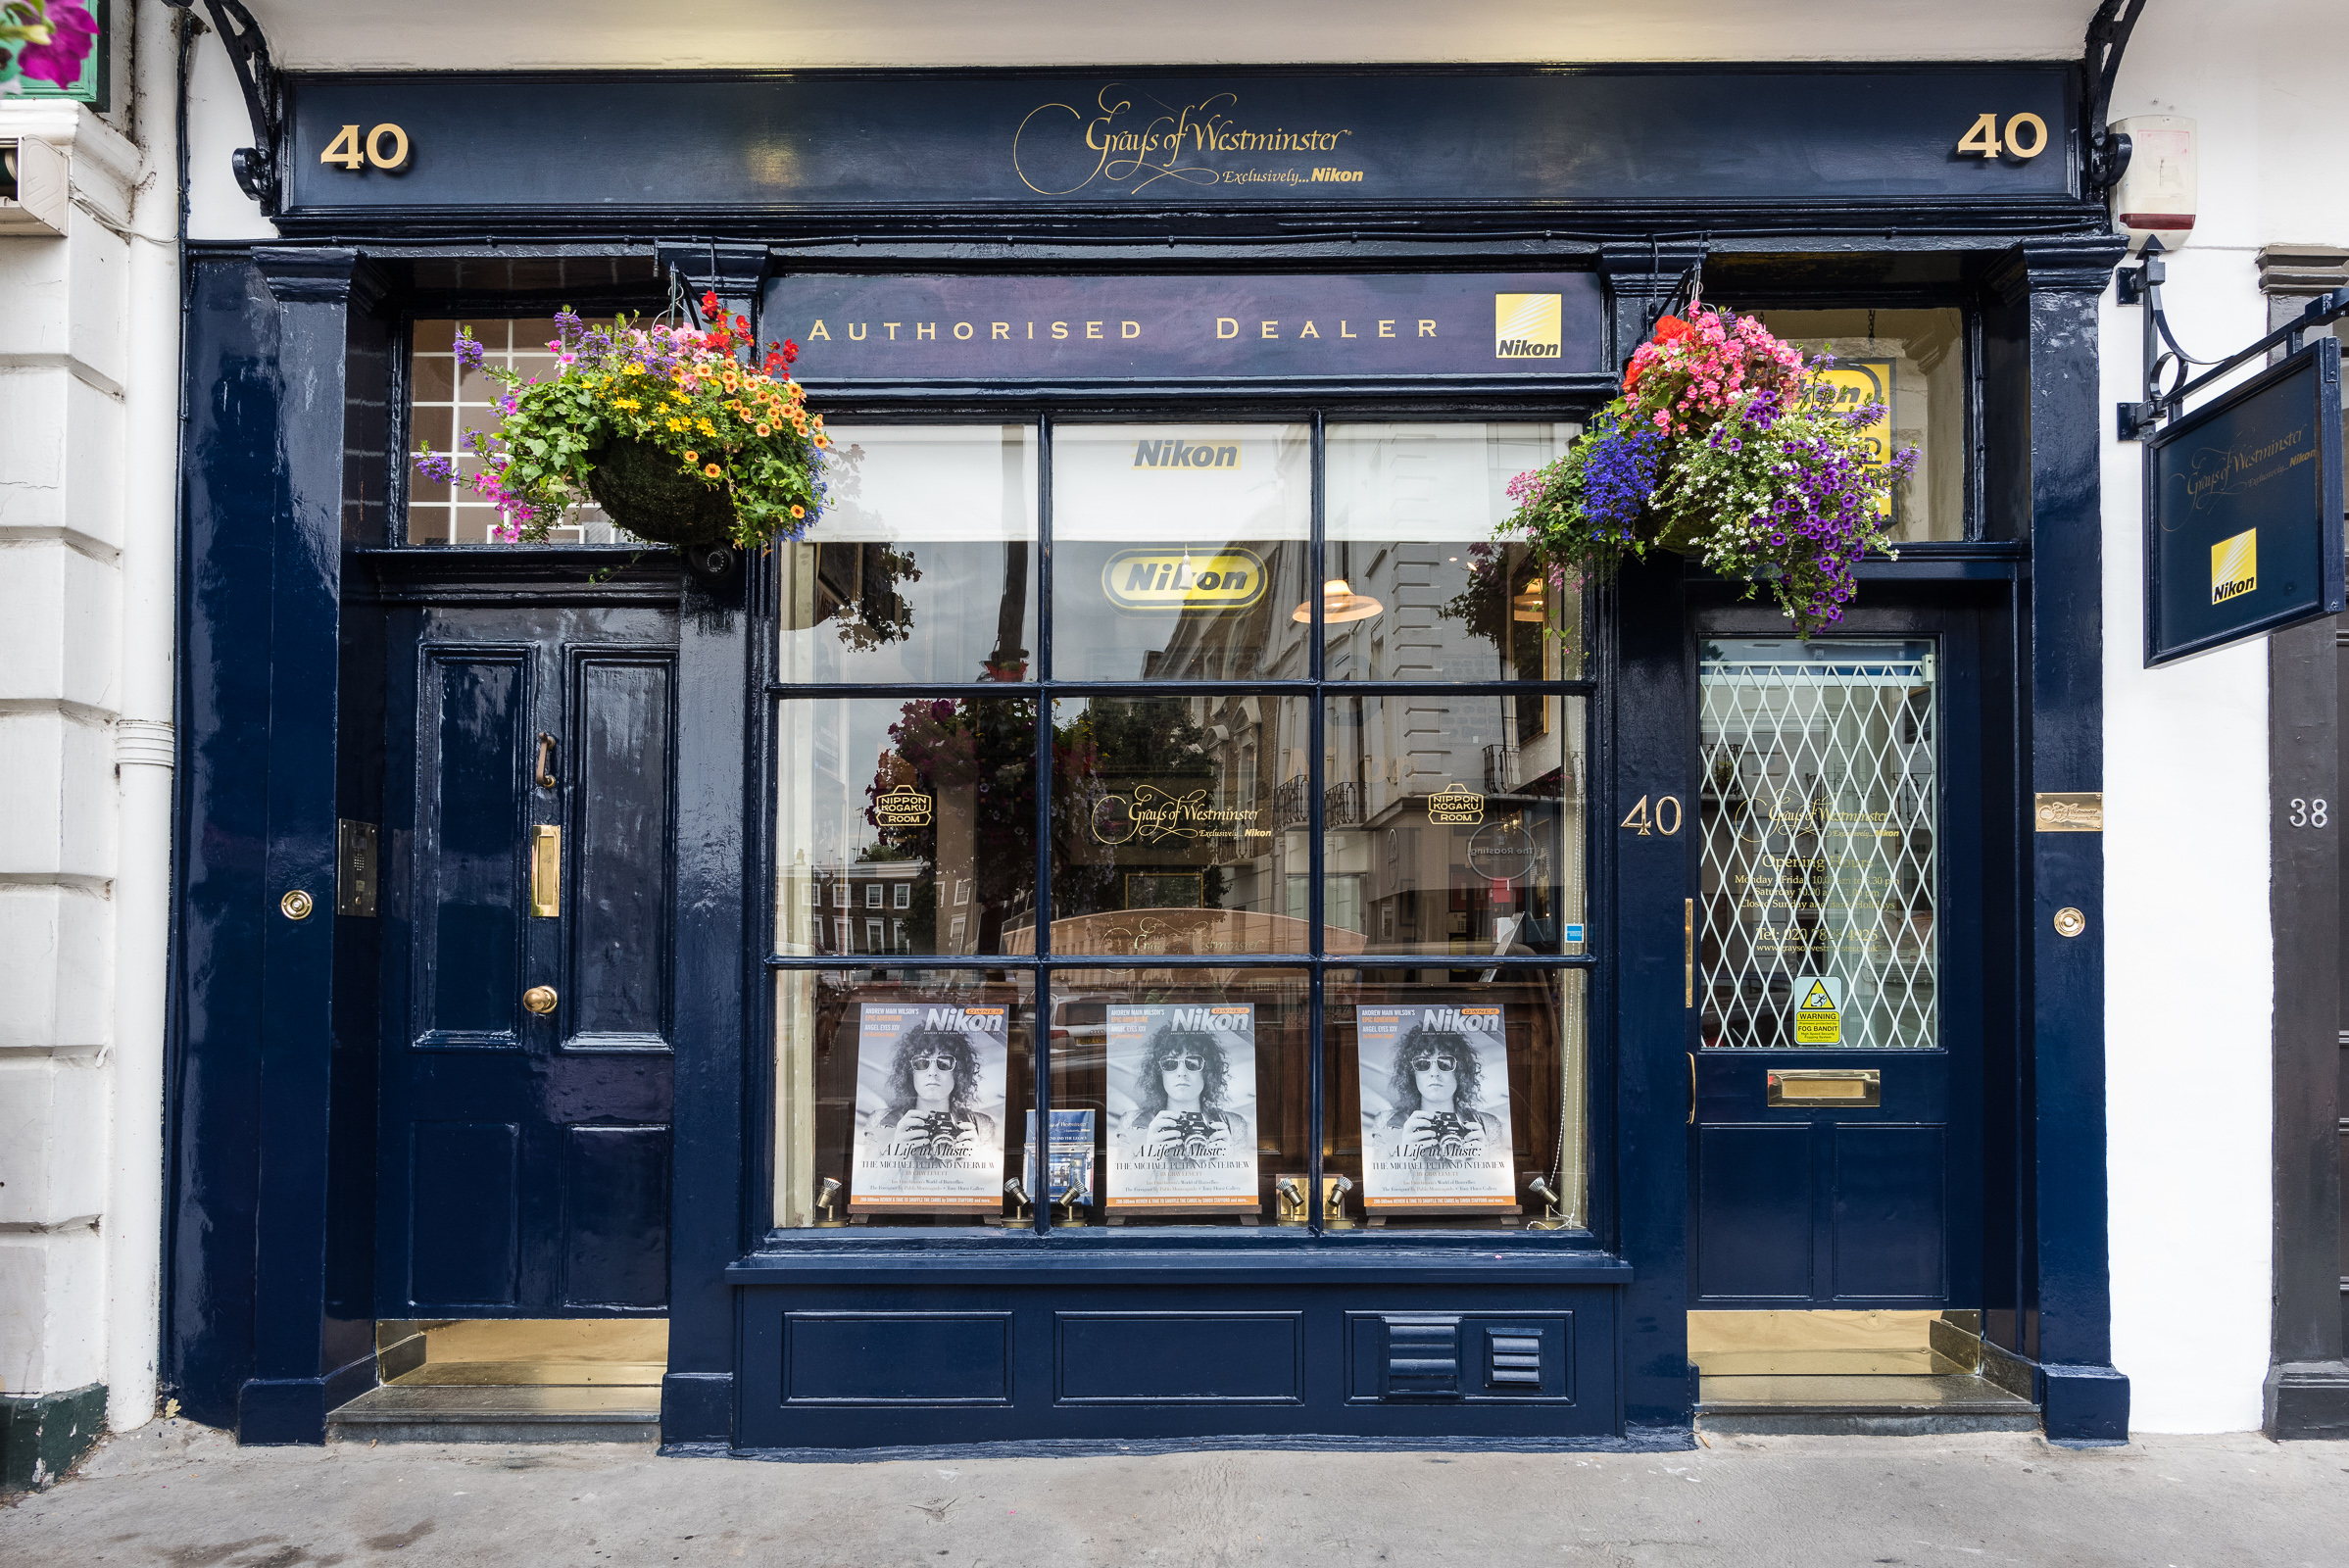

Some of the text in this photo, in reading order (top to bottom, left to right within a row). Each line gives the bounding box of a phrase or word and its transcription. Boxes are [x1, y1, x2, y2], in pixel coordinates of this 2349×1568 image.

[1163, 104, 1194, 167] of
[1185, 110, 1352, 152] Westminster
[1957, 112, 2047, 159] 40
[320, 122, 410, 171] 40
[1311, 168, 1363, 182] Nikon
[807, 318, 1439, 341] AUTHORISED DEALER
[1497, 338, 1560, 359] Nikon
[1134, 440, 1238, 467] Nikon
[2230, 424, 2308, 473] Westminster
[2289, 449, 2317, 468] Nikon
[2213, 576, 2255, 603] Nikon
[1433, 795, 1479, 804] NIPPON
[1181, 800, 1263, 821] Westminster
[1620, 794, 1682, 836] 40
[2289, 798, 2328, 829] 38
[1762, 855, 1874, 872] Opening Hours
[1735, 875, 1773, 886] Monday
[1754, 887, 1795, 898] Saturday
[1739, 899, 1770, 908] Closed
[1809, 900, 1826, 908] and
[1756, 927, 1780, 941] Tel:
[1784, 928, 1807, 941] 020
[1846, 929, 1879, 941] 4925
[924, 1007, 1003, 1032] Nikon
[1170, 1007, 1249, 1032] Nikon
[1422, 1008, 1499, 1032] Nikon
[882, 1144, 891, 1156] A
[894, 1143, 916, 1159] Life
[919, 1144, 931, 1156] in
[1135, 1144, 1145, 1157] A
[1148, 1144, 1170, 1160] Life
[1173, 1145, 1185, 1157] in
[1391, 1145, 1400, 1157] A
[1402, 1144, 1426, 1160] Life
[1429, 1145, 1441, 1157] in
[862, 1160, 996, 1169] THE MICHAEL PUTLAND INTERVIEW
[1115, 1161, 1250, 1170] THE MICHAEL PUTLAND INTERVIEW
[1371, 1161, 1505, 1170] THE MICHAEL PUTLAND INTERVIEW
